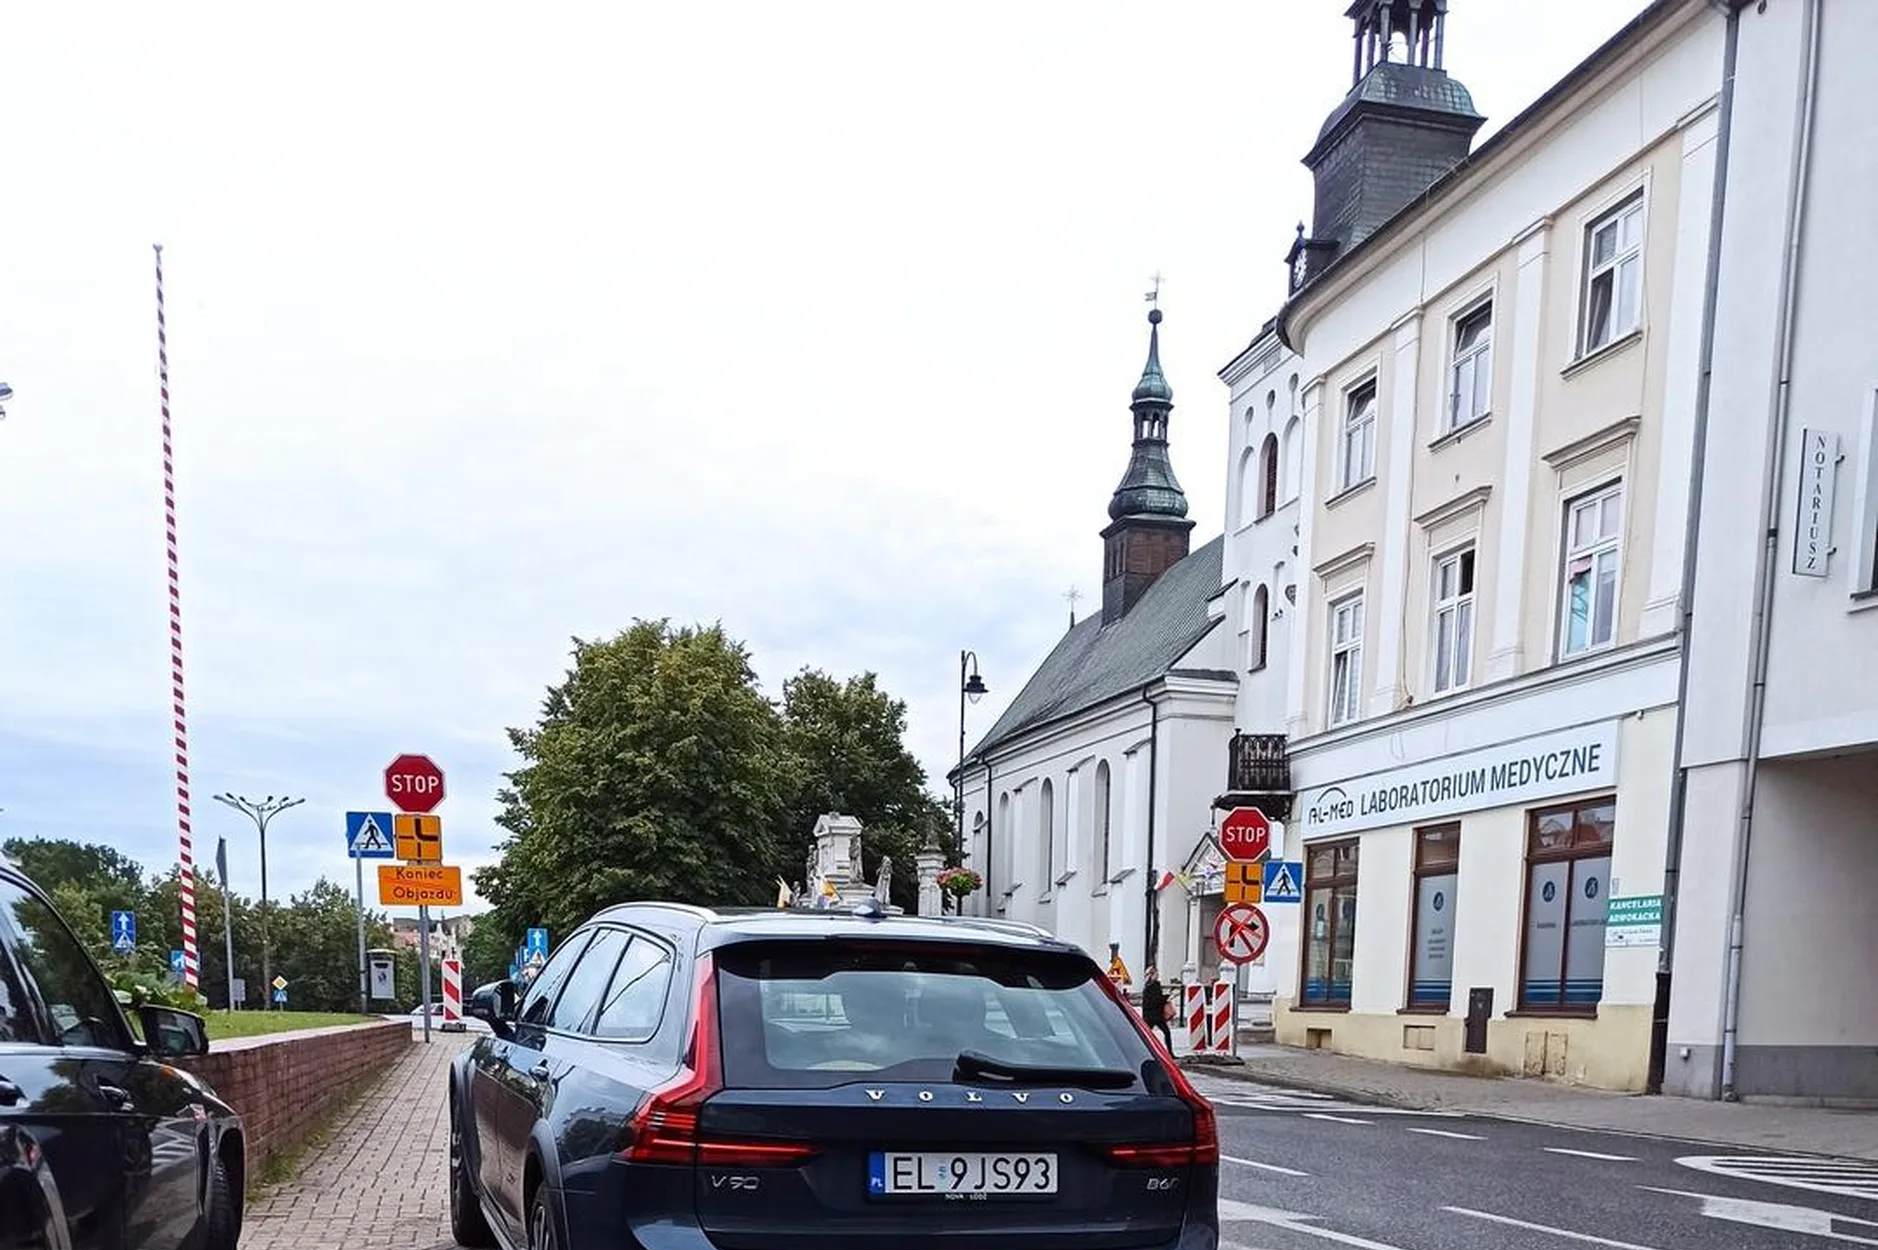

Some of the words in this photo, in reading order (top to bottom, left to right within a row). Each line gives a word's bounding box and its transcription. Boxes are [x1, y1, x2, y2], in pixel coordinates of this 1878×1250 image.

[1806, 435, 1827, 570] NOTARIUSZ
[391, 774, 439, 794] STOP
[1360, 768, 1485, 816] LABORATORIUM
[1490, 743, 1602, 792] MEDYCZNE
[1226, 826, 1266, 842] STOP
[395, 867, 444, 880] Koniec
[393, 886, 453, 901] Objazdu
[865, 1089, 1074, 1104] VOLVO
[893, 1157, 935, 1190] EL
[950, 1157, 1050, 1190] 9JS93
[711, 1175, 760, 1190] V90
